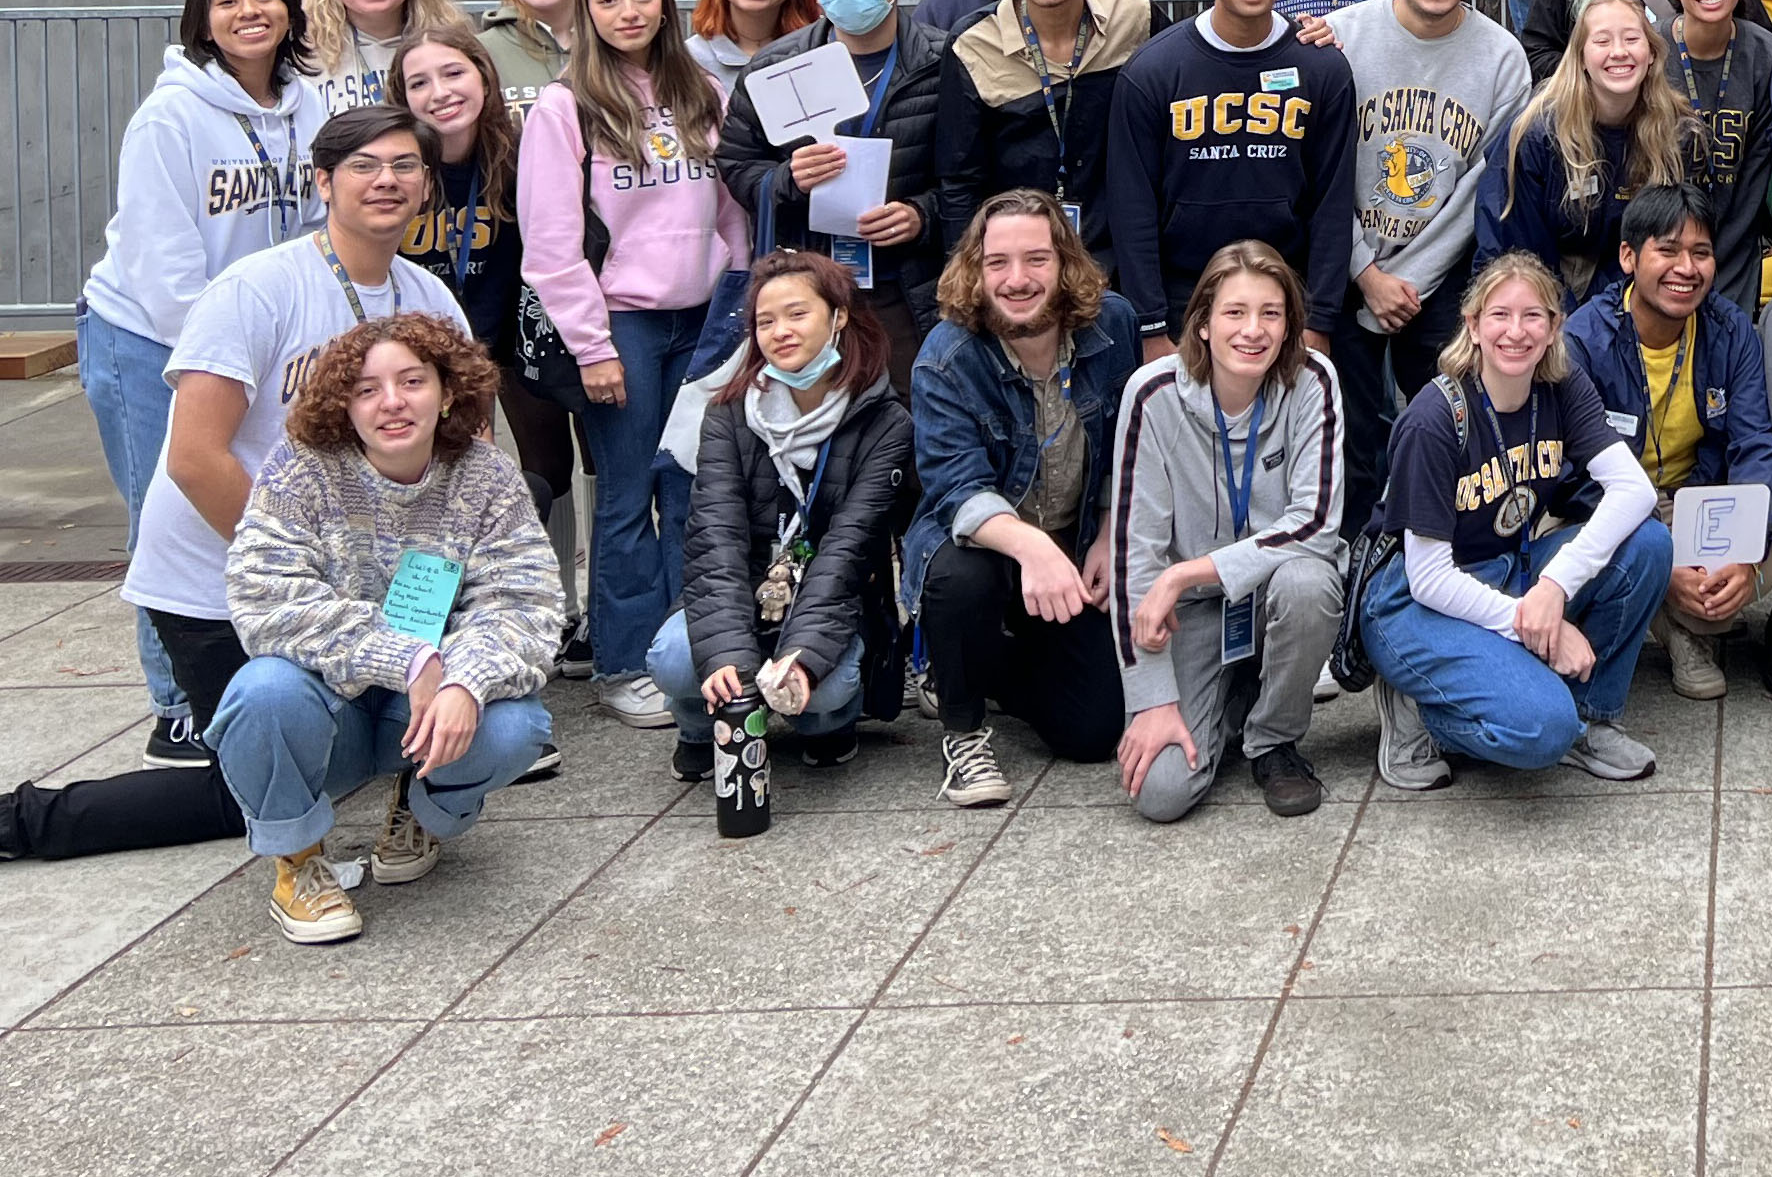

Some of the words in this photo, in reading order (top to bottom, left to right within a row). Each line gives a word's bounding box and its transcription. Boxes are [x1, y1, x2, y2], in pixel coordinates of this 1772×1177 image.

[1169, 91, 1312, 141] UCSC
[1380, 87, 1437, 136] SANTA
[1440, 96, 1485, 163] CRUZ
[612, 156, 718, 191] SLUGS
[1188, 144, 1240, 160] SANTA
[1246, 144, 1288, 159] CRUZ
[1455, 471, 1481, 512] UC
[1694, 497, 1736, 557] E
